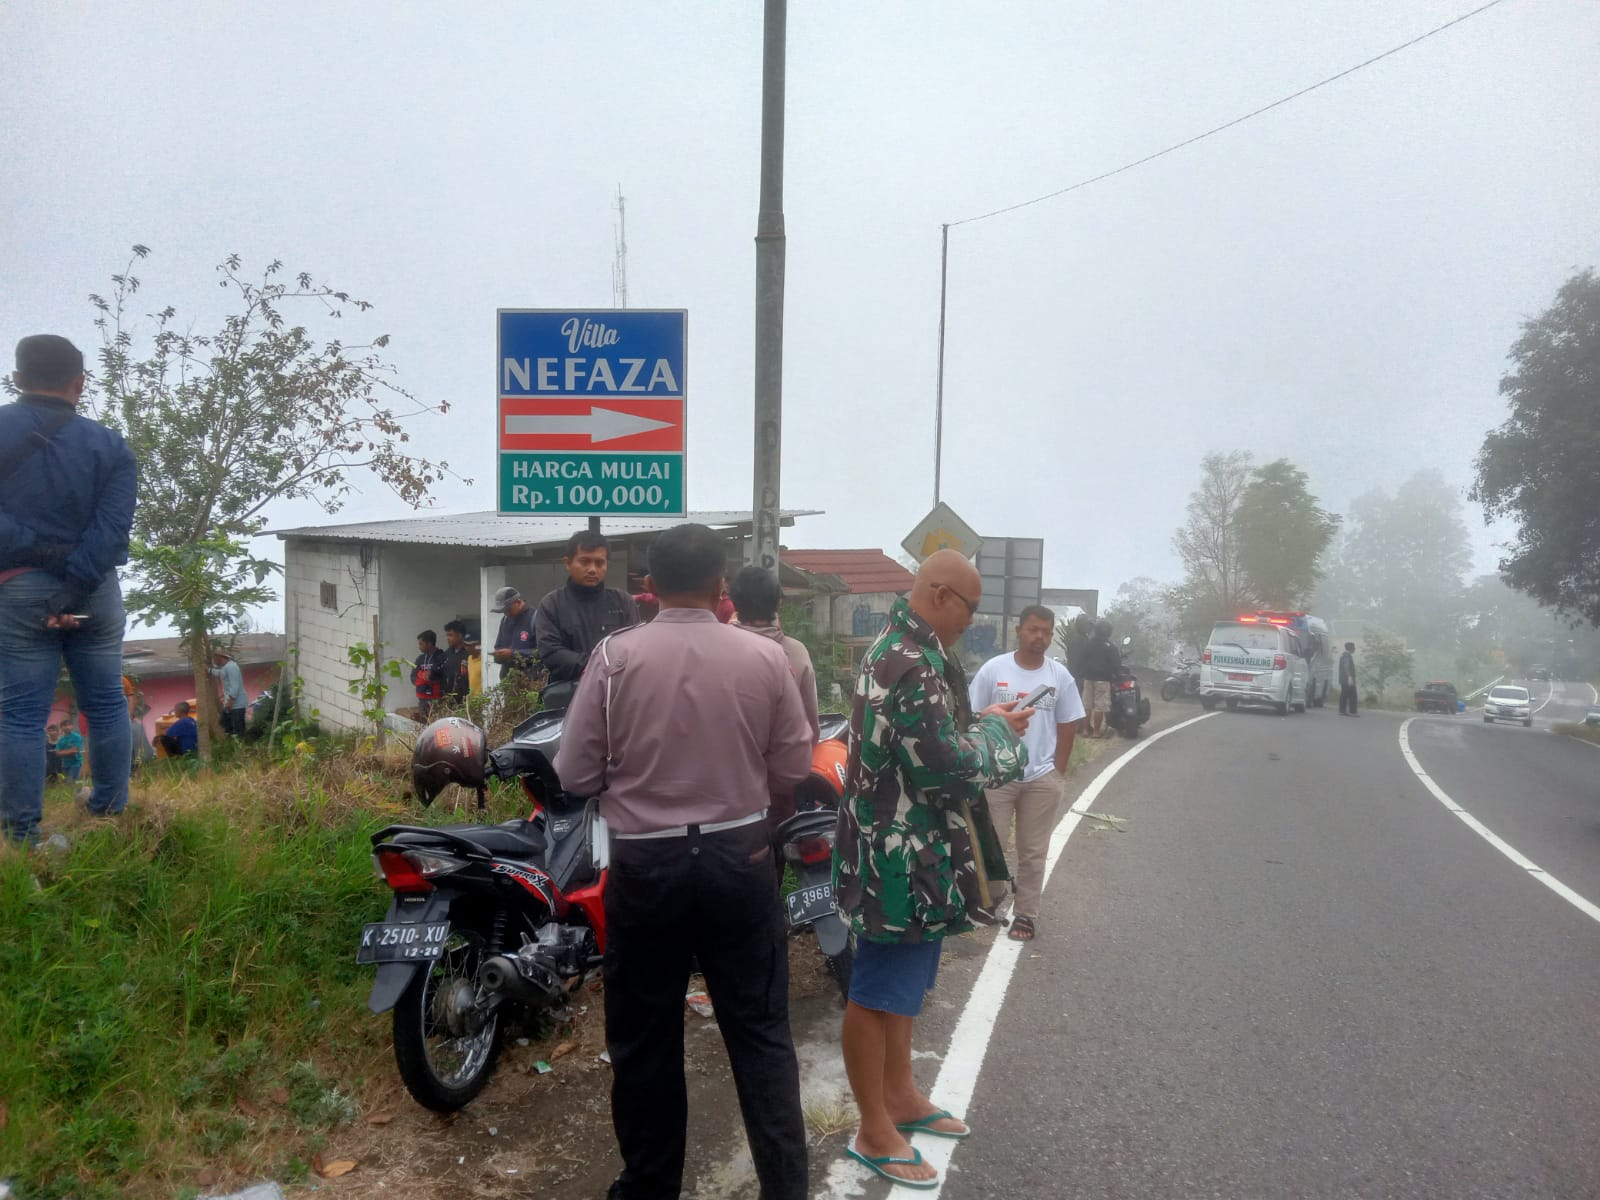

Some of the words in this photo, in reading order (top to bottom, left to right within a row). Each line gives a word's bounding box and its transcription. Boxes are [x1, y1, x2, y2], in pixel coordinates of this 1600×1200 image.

[561, 317, 620, 354] Villa
[503, 357, 679, 392] NEFAZA
[513, 460, 593, 479] HARGA
[601, 461, 670, 480] MULAI
[512, 484, 670, 510] Rp.100,000,
[789, 895, 796, 909] P
[802, 886, 830, 904] 3968
[362, 928, 374, 947] K
[380, 928, 416, 946] 2510
[424, 925, 446, 943] XU
